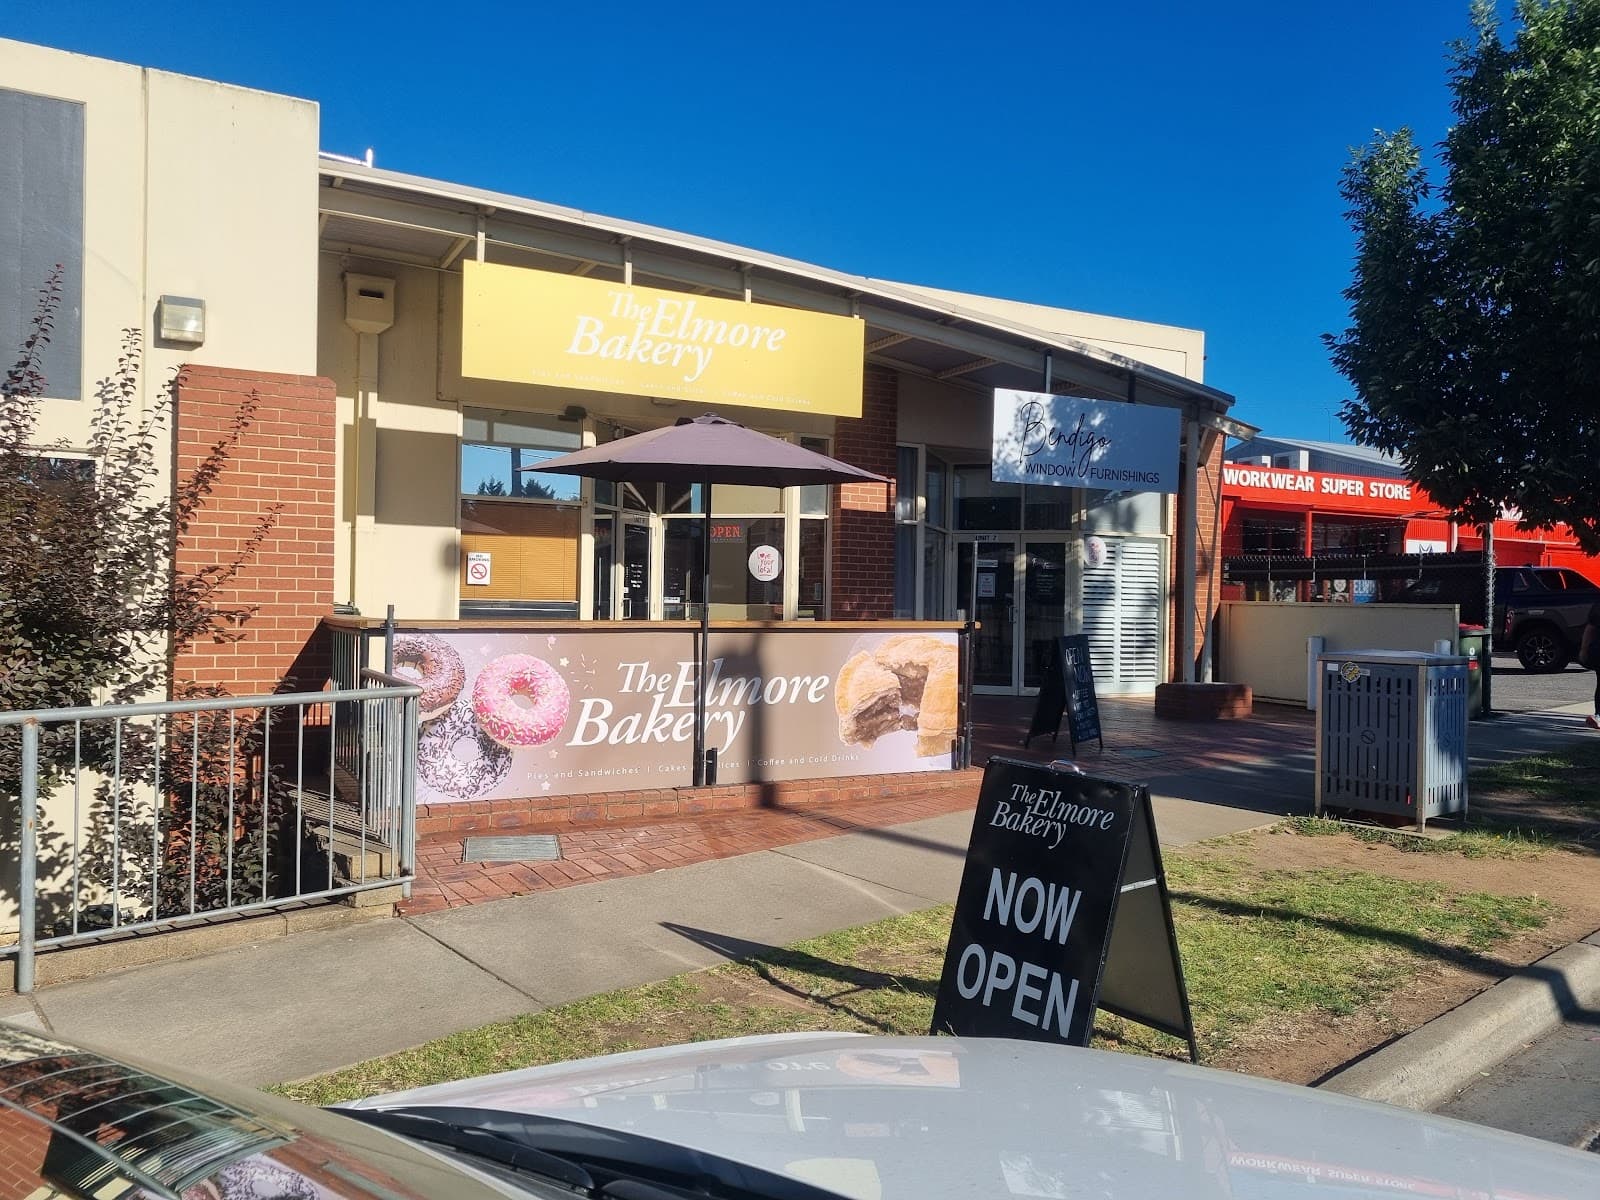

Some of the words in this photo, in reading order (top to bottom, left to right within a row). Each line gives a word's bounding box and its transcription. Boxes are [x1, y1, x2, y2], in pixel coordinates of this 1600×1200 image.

[608, 290, 652, 320] The
[648, 298, 786, 351] Elmore
[567, 315, 713, 383] Bakery
[1019, 401, 1112, 478] Bendigo
[1025, 462, 1076, 477] WINDOW
[1090, 467, 1160, 483] FURNISHINGS
[1223, 468, 1315, 492] WORKWEAR
[1321, 477, 1364, 497] SUPER
[1369, 482, 1411, 500] STORE
[617, 661, 673, 693] The
[664, 658, 829, 707] Elmore
[565, 693, 745, 756] Bakery
[527, 772, 549, 780] Pies
[578, 767, 641, 777] Sandwiches
[658, 764, 687, 773] Cakes
[757, 758, 785, 767] Coffee
[809, 754, 828, 763] Cold
[832, 753, 860, 762] Drinks
[989, 801, 1067, 850] Bakery
[1010, 783, 1037, 804] The
[1031, 789, 1115, 830] Elmore
[983, 867, 1082, 945] NOW
[956, 943, 1079, 1039] OPEN
